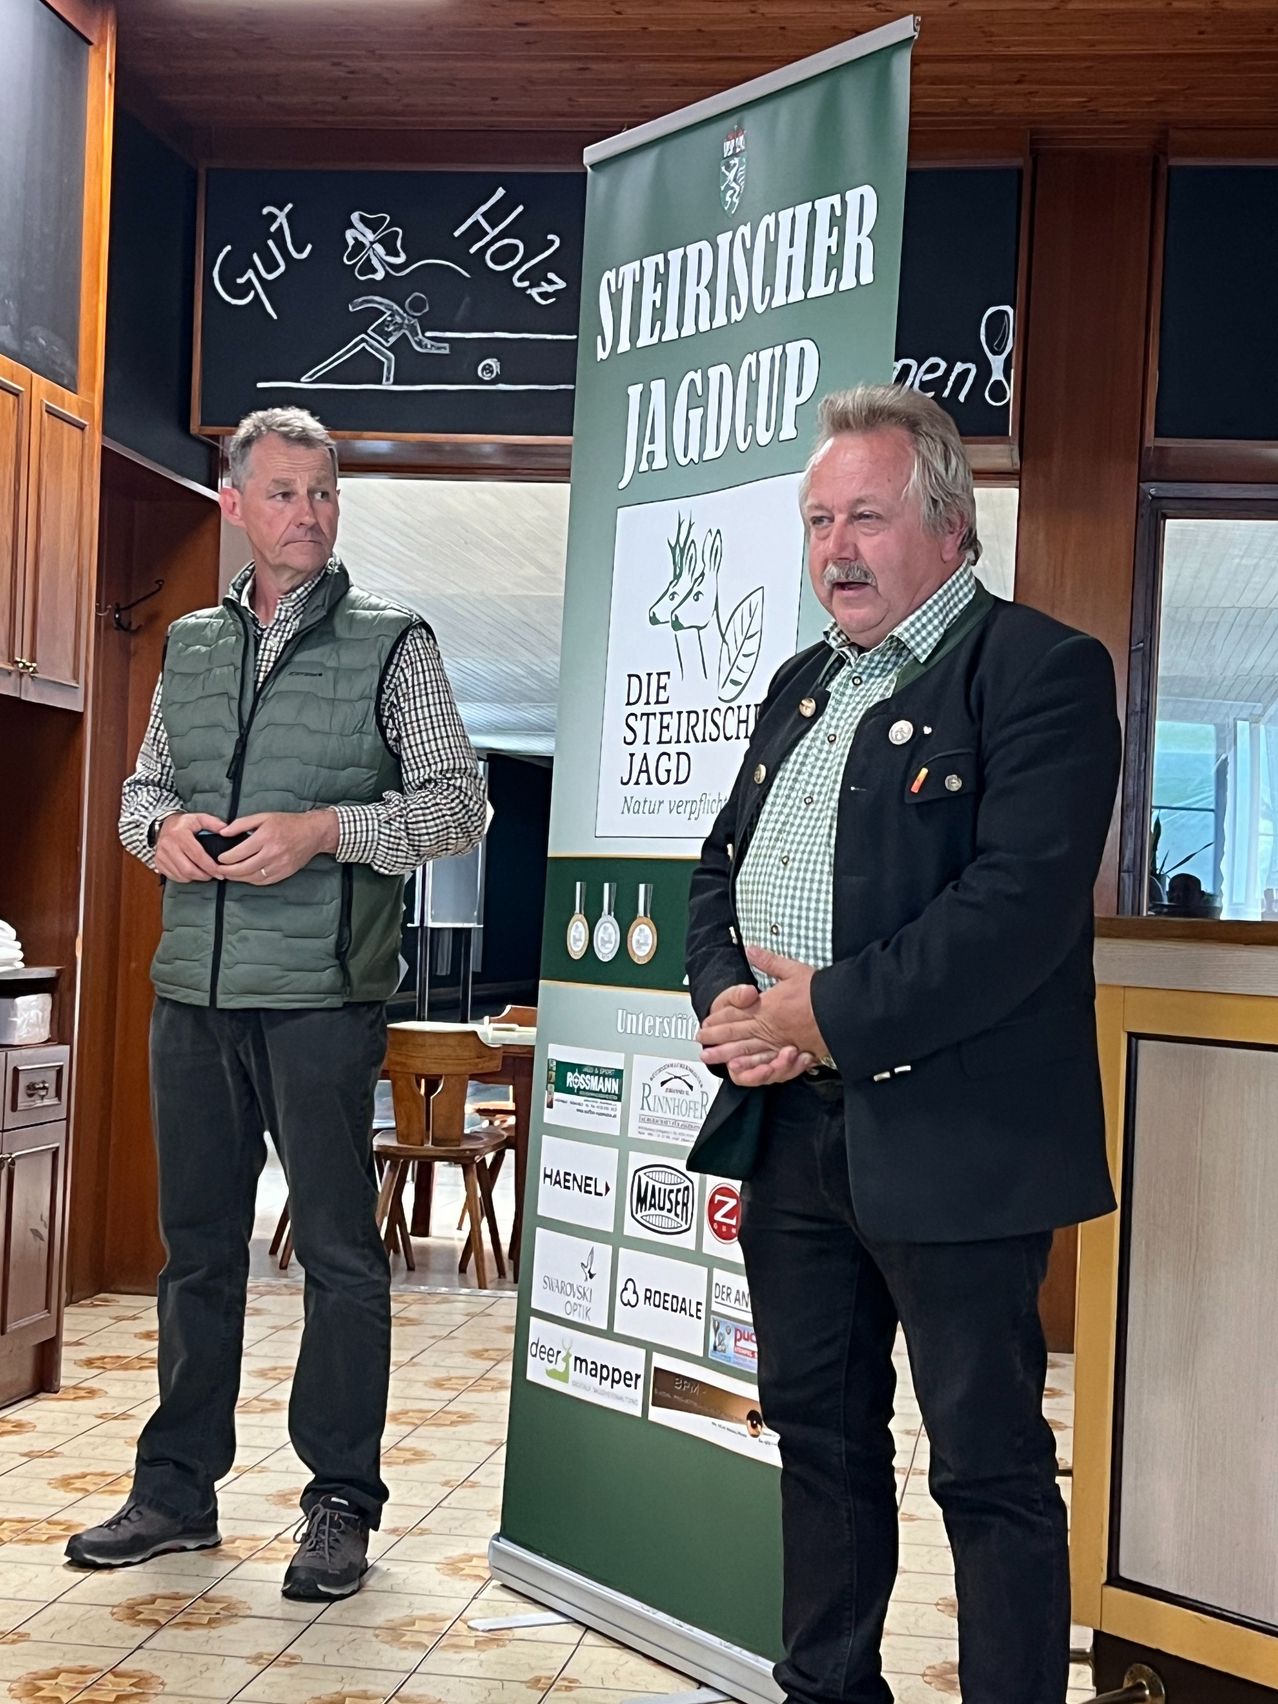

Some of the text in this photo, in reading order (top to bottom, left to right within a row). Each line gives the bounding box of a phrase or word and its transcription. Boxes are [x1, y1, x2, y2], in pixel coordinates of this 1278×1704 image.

[212, 186, 567, 319] Gut Holz
[596, 184, 879, 362] STEIRISCHER
[617, 337, 820, 490] JAGDCUP
[625, 671, 671, 706] DIE
[620, 751, 691, 785] JAGD
[621, 796, 664, 815] Natur
[566, 1070, 619, 1095] ROSSMANN
[543, 1166, 604, 1197] HAENEL
[635, 1174, 690, 1226] MAUSER
[713, 1193, 738, 1226] Z
[542, 1275, 593, 1303] SWAROVSKI
[643, 1287, 703, 1320] ROEDALE
[714, 1282, 732, 1304] DER
[564, 1300, 592, 1322] OPTIK
[529, 1337, 642, 1391] deer mapper
